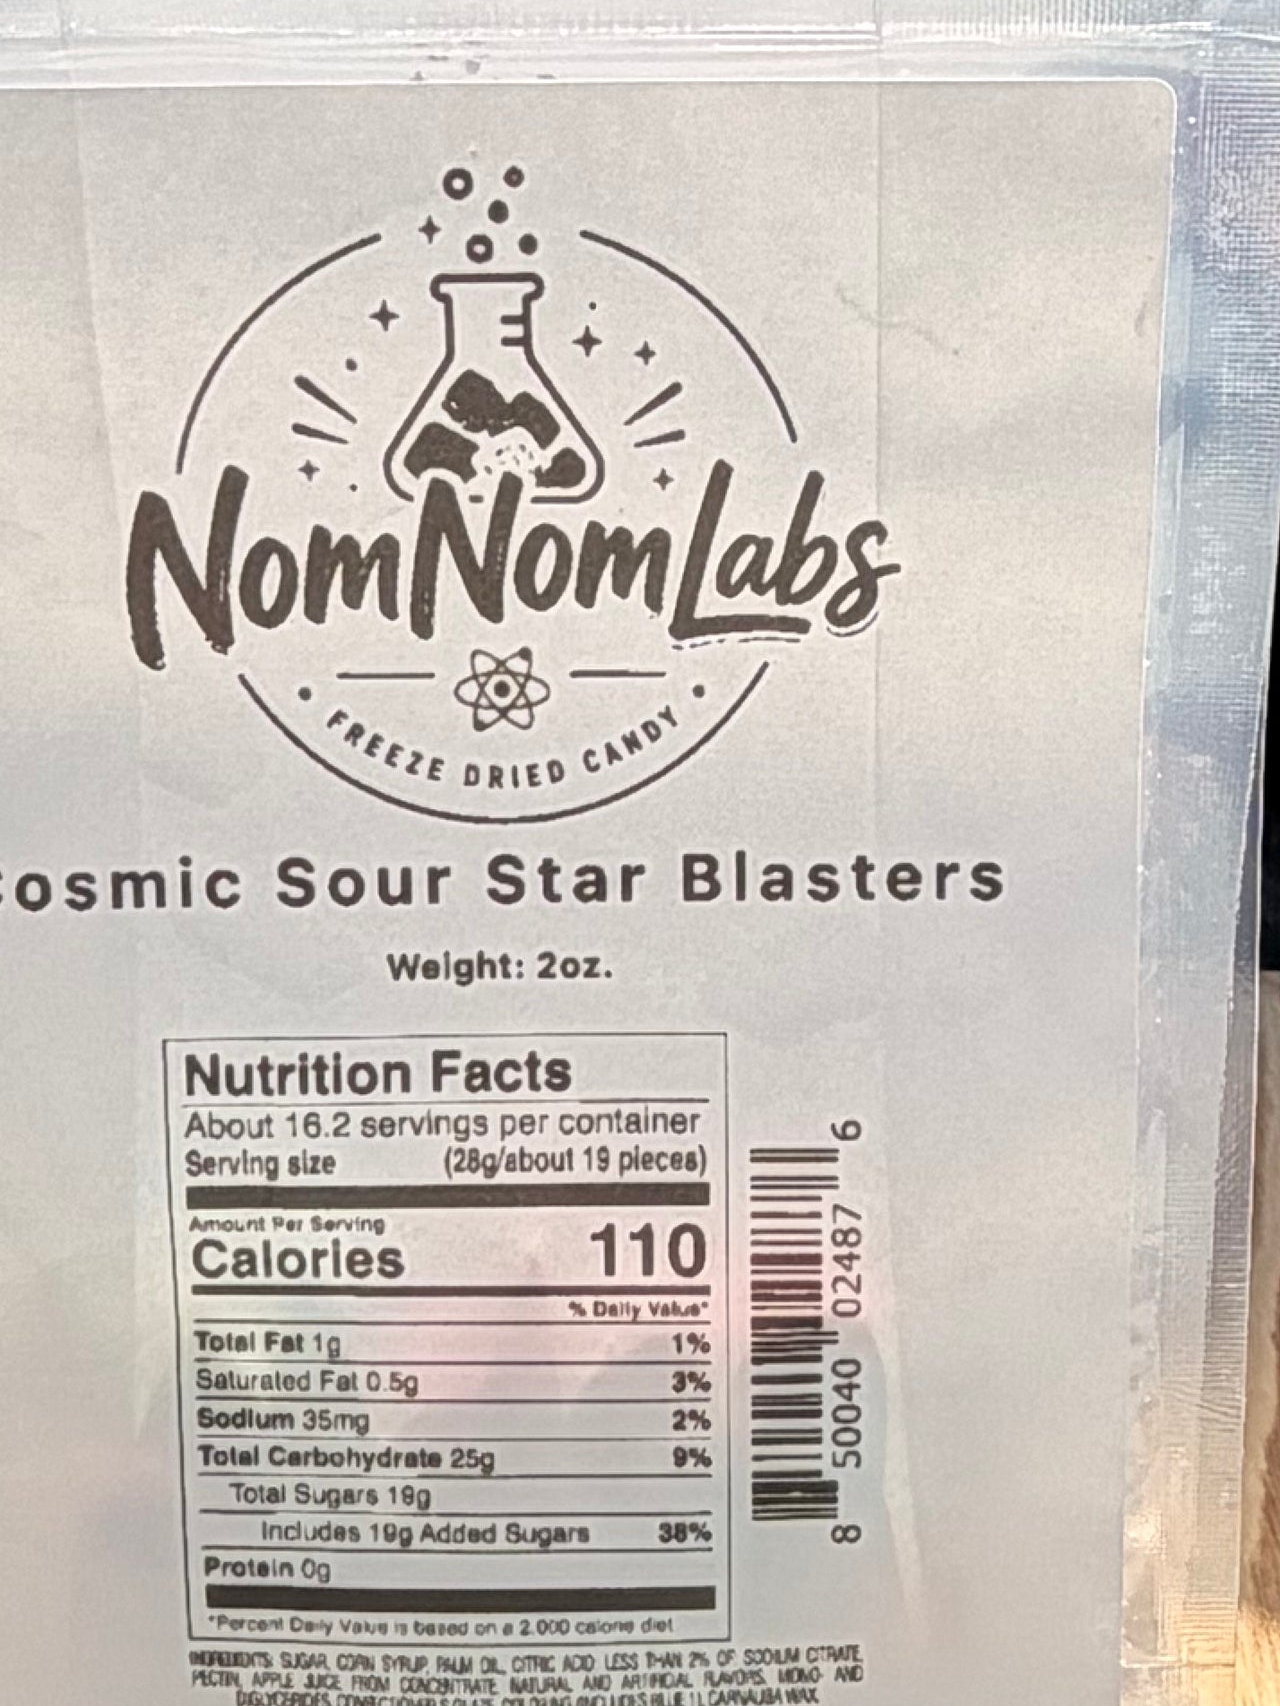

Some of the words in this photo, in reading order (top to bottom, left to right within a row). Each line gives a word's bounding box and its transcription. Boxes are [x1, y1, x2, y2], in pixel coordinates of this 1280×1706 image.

[126, 460, 901, 671] NomNomLabs
[322, 709, 445, 784] FREEZE
[463, 759, 565, 789] DRIED
[582, 705, 683, 776] CANDY
[276, 856, 451, 908] Sour
[486, 853, 646, 905] Star
[682, 849, 1003, 903] Blasters
[386, 950, 524, 987] Weight:
[537, 951, 613, 979] 2oz.
[185, 1051, 411, 1097] Nutrition
[432, 1049, 572, 1094] Facts
[183, 1111, 275, 1140] About
[285, 1111, 351, 1139] 16.2
[360, 1109, 489, 1143] servings
[500, 1113, 550, 1142] per
[558, 1106, 701, 1136] container
[830, 1120, 862, 1142] 6
[184, 1148, 280, 1182] Serving
[287, 1148, 337, 1177] size
[444, 1145, 574, 1180] (28g/about
[583, 1145, 610, 1173] 19
[618, 1144, 707, 1178] pieces)
[188, 1215, 266, 1233] Amount
[271, 1216, 303, 1233] Per
[310, 1215, 386, 1237] Serving
[192, 1237, 405, 1280] Calories
[590, 1222, 707, 1278] 110
[830, 1203, 862, 1319] 02487
[589, 1300, 646, 1324] Daily
[193, 1330, 255, 1353] Total
[264, 1330, 305, 1354] Fat
[309, 1332, 345, 1362] 1g
[672, 1332, 712, 1355] 1%
[195, 1367, 311, 1392] Saturated
[319, 1369, 359, 1393] Fat
[362, 1370, 423, 1401] 0.5g
[671, 1370, 712, 1394] 3%
[197, 1406, 295, 1430] Sodium
[302, 1408, 370, 1438] 35mg
[672, 1408, 712, 1432] 2%
[830, 1358, 862, 1469] 50040
[197, 1443, 260, 1466] Total
[267, 1445, 443, 1473] Carbohydrate
[446, 1447, 498, 1479] 25g
[672, 1446, 713, 1468] 9%
[228, 1482, 287, 1505] Total
[294, 1482, 379, 1513] Sugars
[261, 1520, 361, 1543] Includes
[419, 1522, 497, 1545] Added
[505, 1522, 590, 1550] Sugars
[658, 1522, 713, 1544] 38%
[830, 1524, 862, 1545] 8
[204, 1556, 294, 1578] Protein
[300, 1557, 331, 1584] 0g
[289, 1615, 333, 1637] Daily
[339, 1619, 389, 1636] Value
[412, 1620, 469, 1637] based
[474, 1622, 497, 1637] on
[502, 1622, 514, 1637] a
[604, 1652, 639, 1672] LESS
